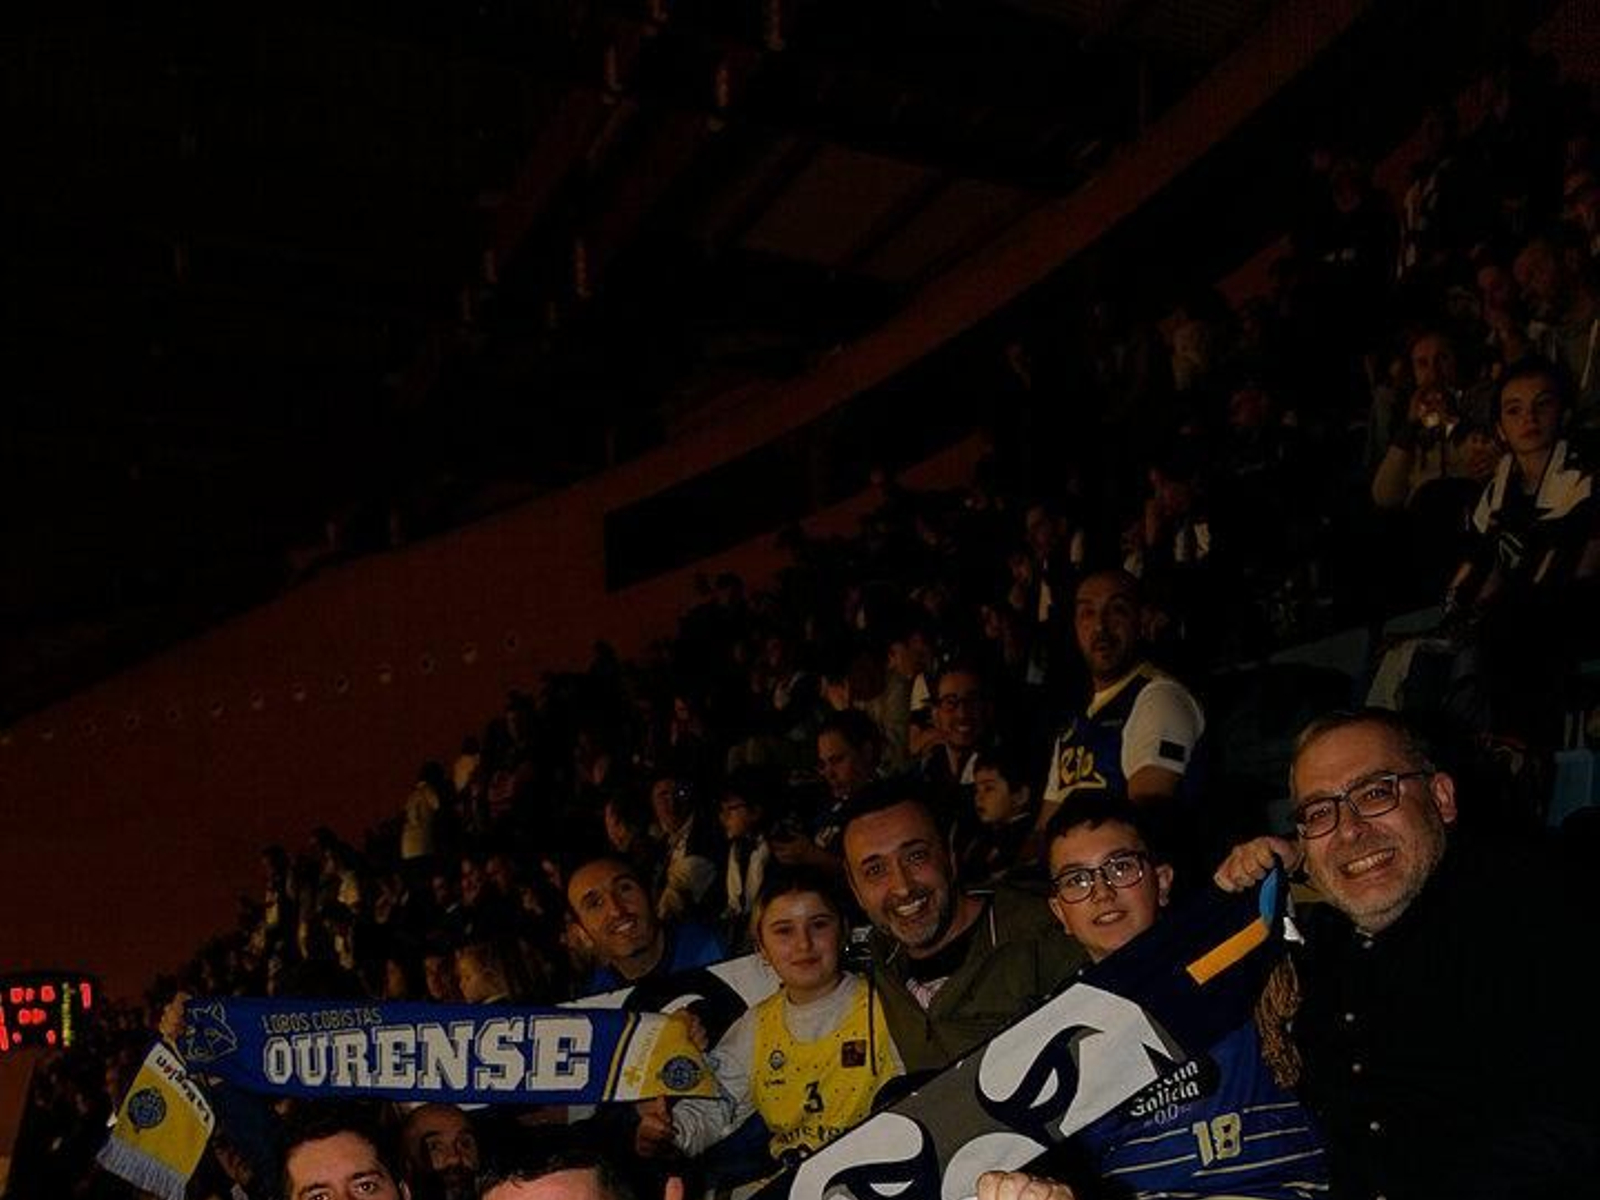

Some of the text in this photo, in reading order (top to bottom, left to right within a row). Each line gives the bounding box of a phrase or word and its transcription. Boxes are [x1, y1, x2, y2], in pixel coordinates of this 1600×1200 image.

[263, 1014, 594, 1091] OURENSE
[803, 1081, 824, 1113] 3
[1191, 1111, 1242, 1167] 18
